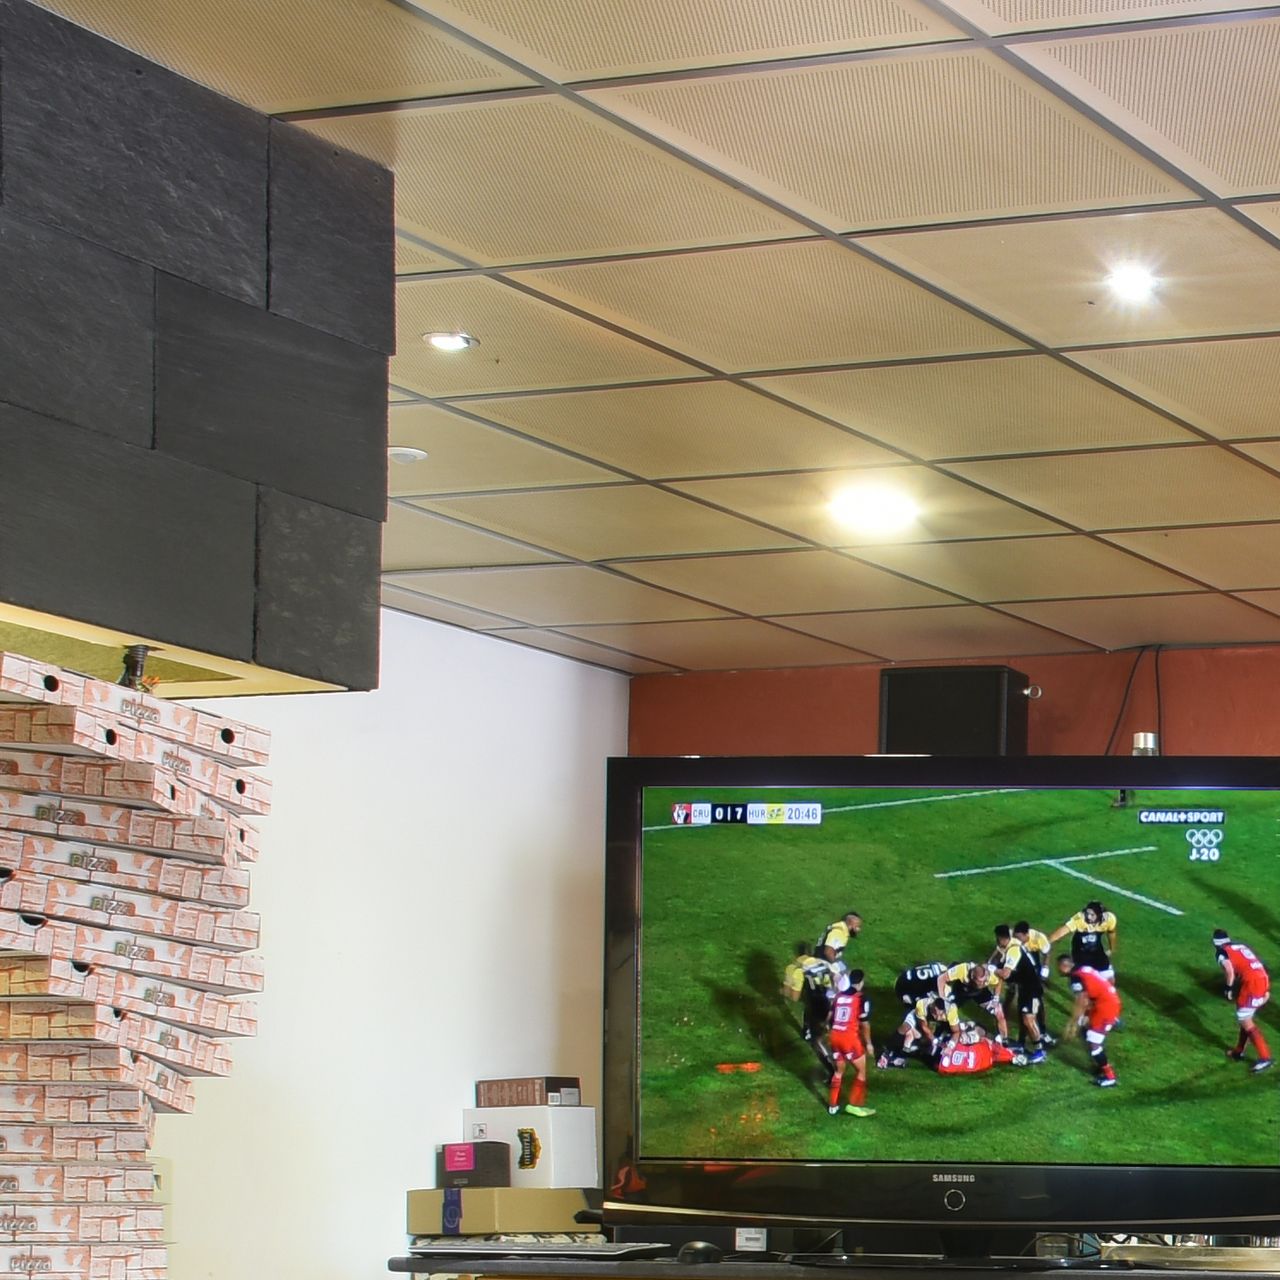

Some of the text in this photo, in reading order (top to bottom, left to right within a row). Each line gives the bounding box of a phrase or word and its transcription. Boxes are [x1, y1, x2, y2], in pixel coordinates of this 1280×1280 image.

[787, 808, 818, 820] 20:46
[1189, 848, 1220, 860] J-20
[932, 1174, 976, 1182] SAMSUNG
